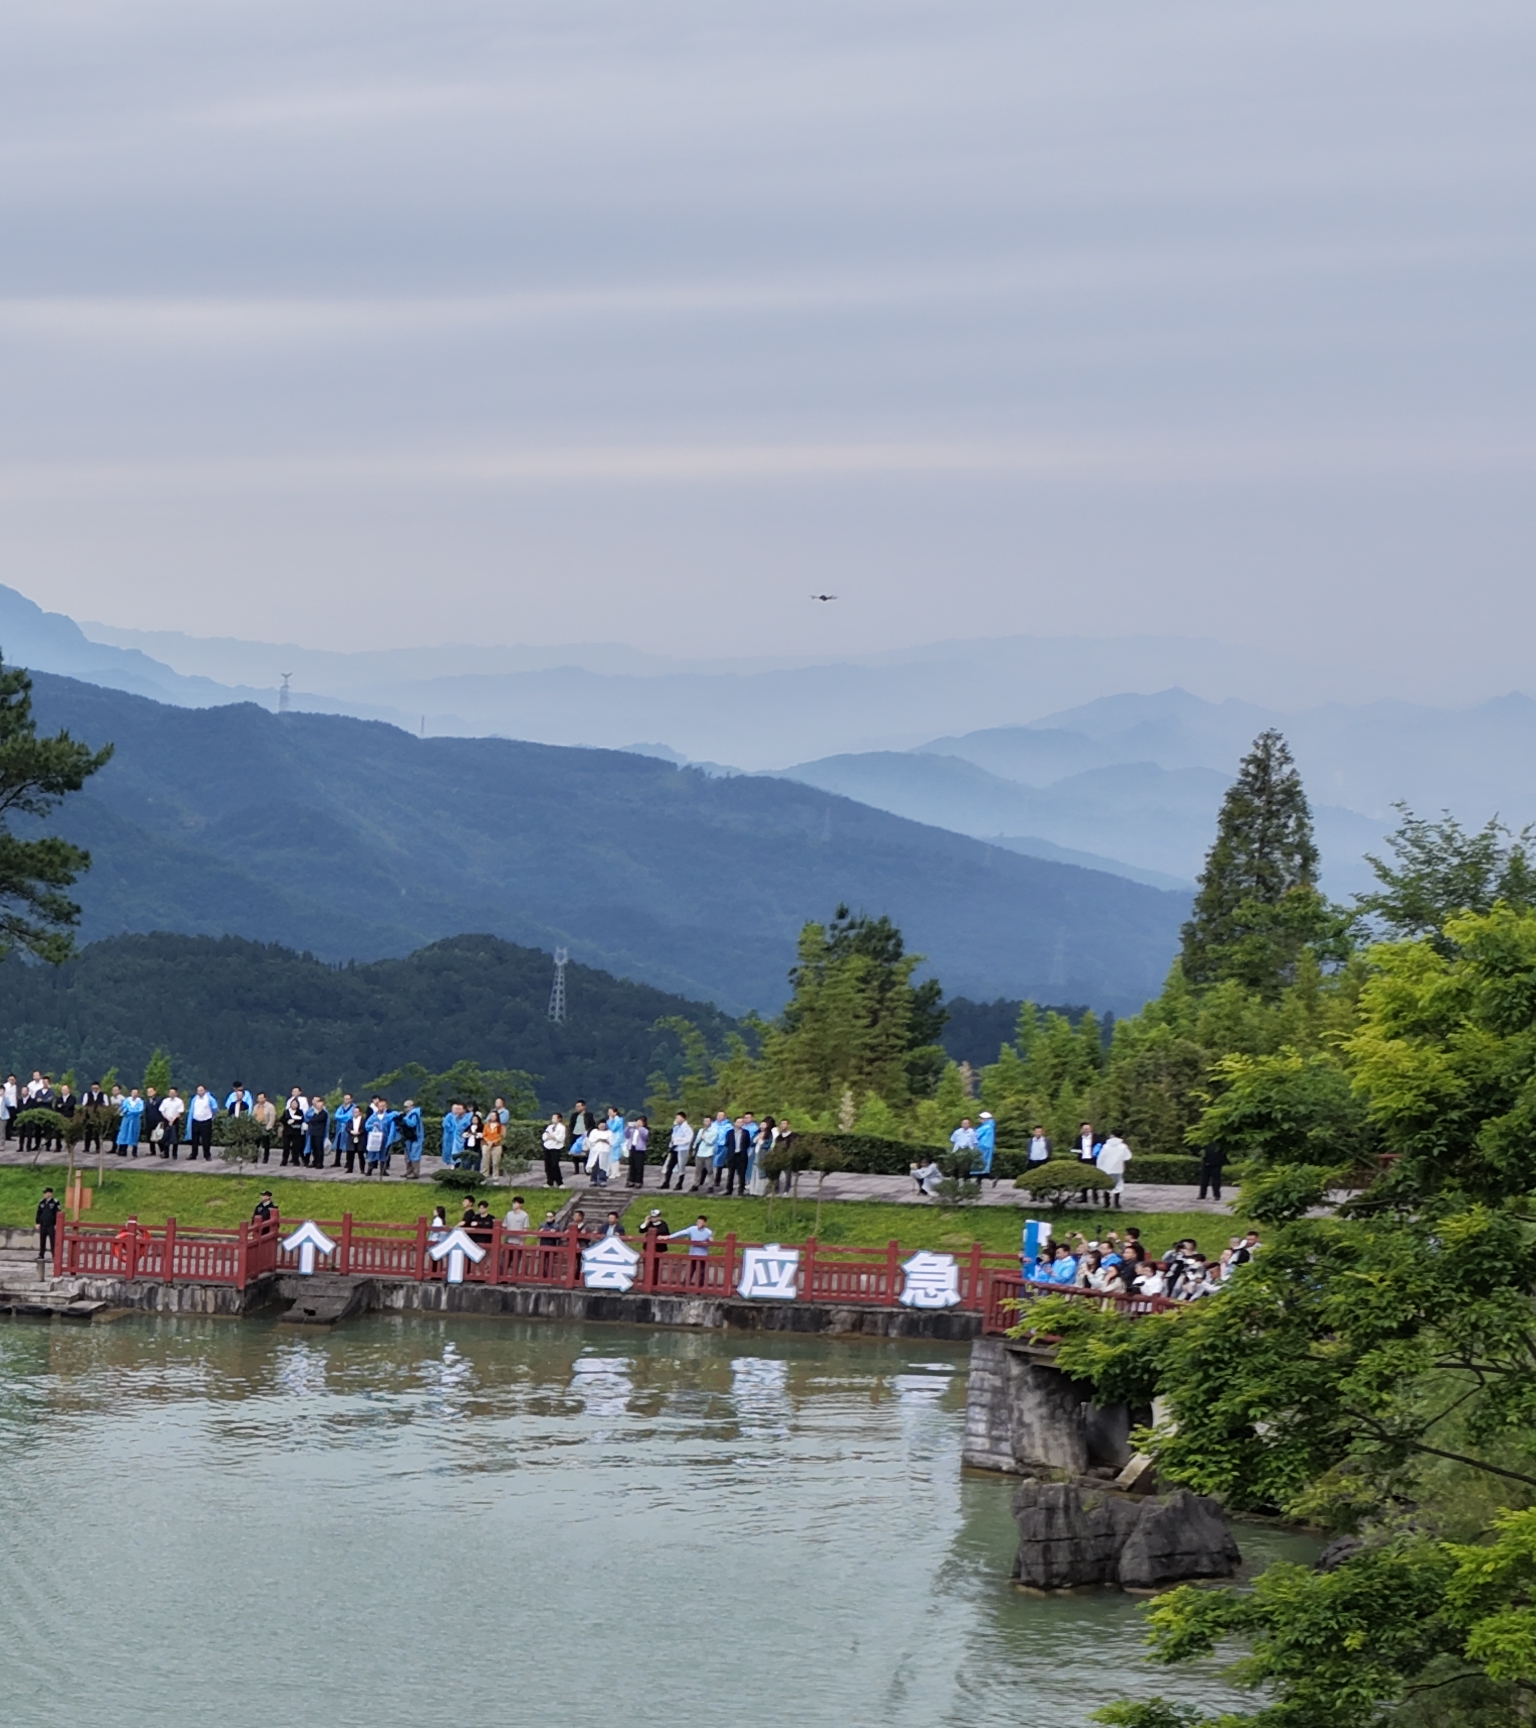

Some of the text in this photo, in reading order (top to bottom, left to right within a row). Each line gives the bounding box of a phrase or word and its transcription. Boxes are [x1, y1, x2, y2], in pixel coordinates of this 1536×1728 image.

[282, 1221, 961, 1308] 个个会应急
